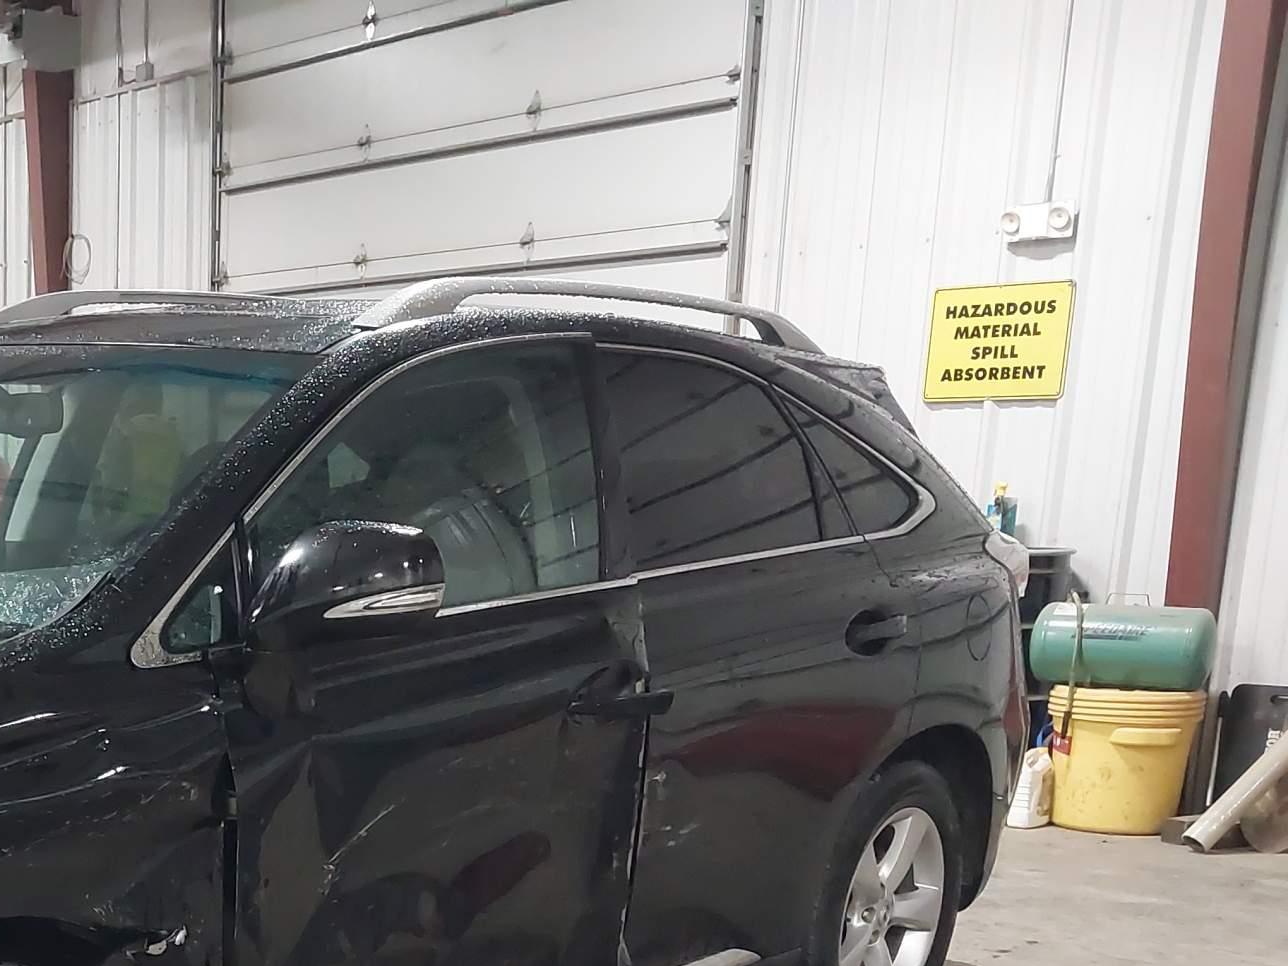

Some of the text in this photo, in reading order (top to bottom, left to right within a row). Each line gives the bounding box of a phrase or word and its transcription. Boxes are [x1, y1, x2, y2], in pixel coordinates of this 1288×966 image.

[945, 300, 1057, 319] HAZARDOUS
[954, 322, 1041, 340] MATERIAL
[970, 345, 1018, 360] SPILL
[940, 365, 1046, 382] ABSORBENT
